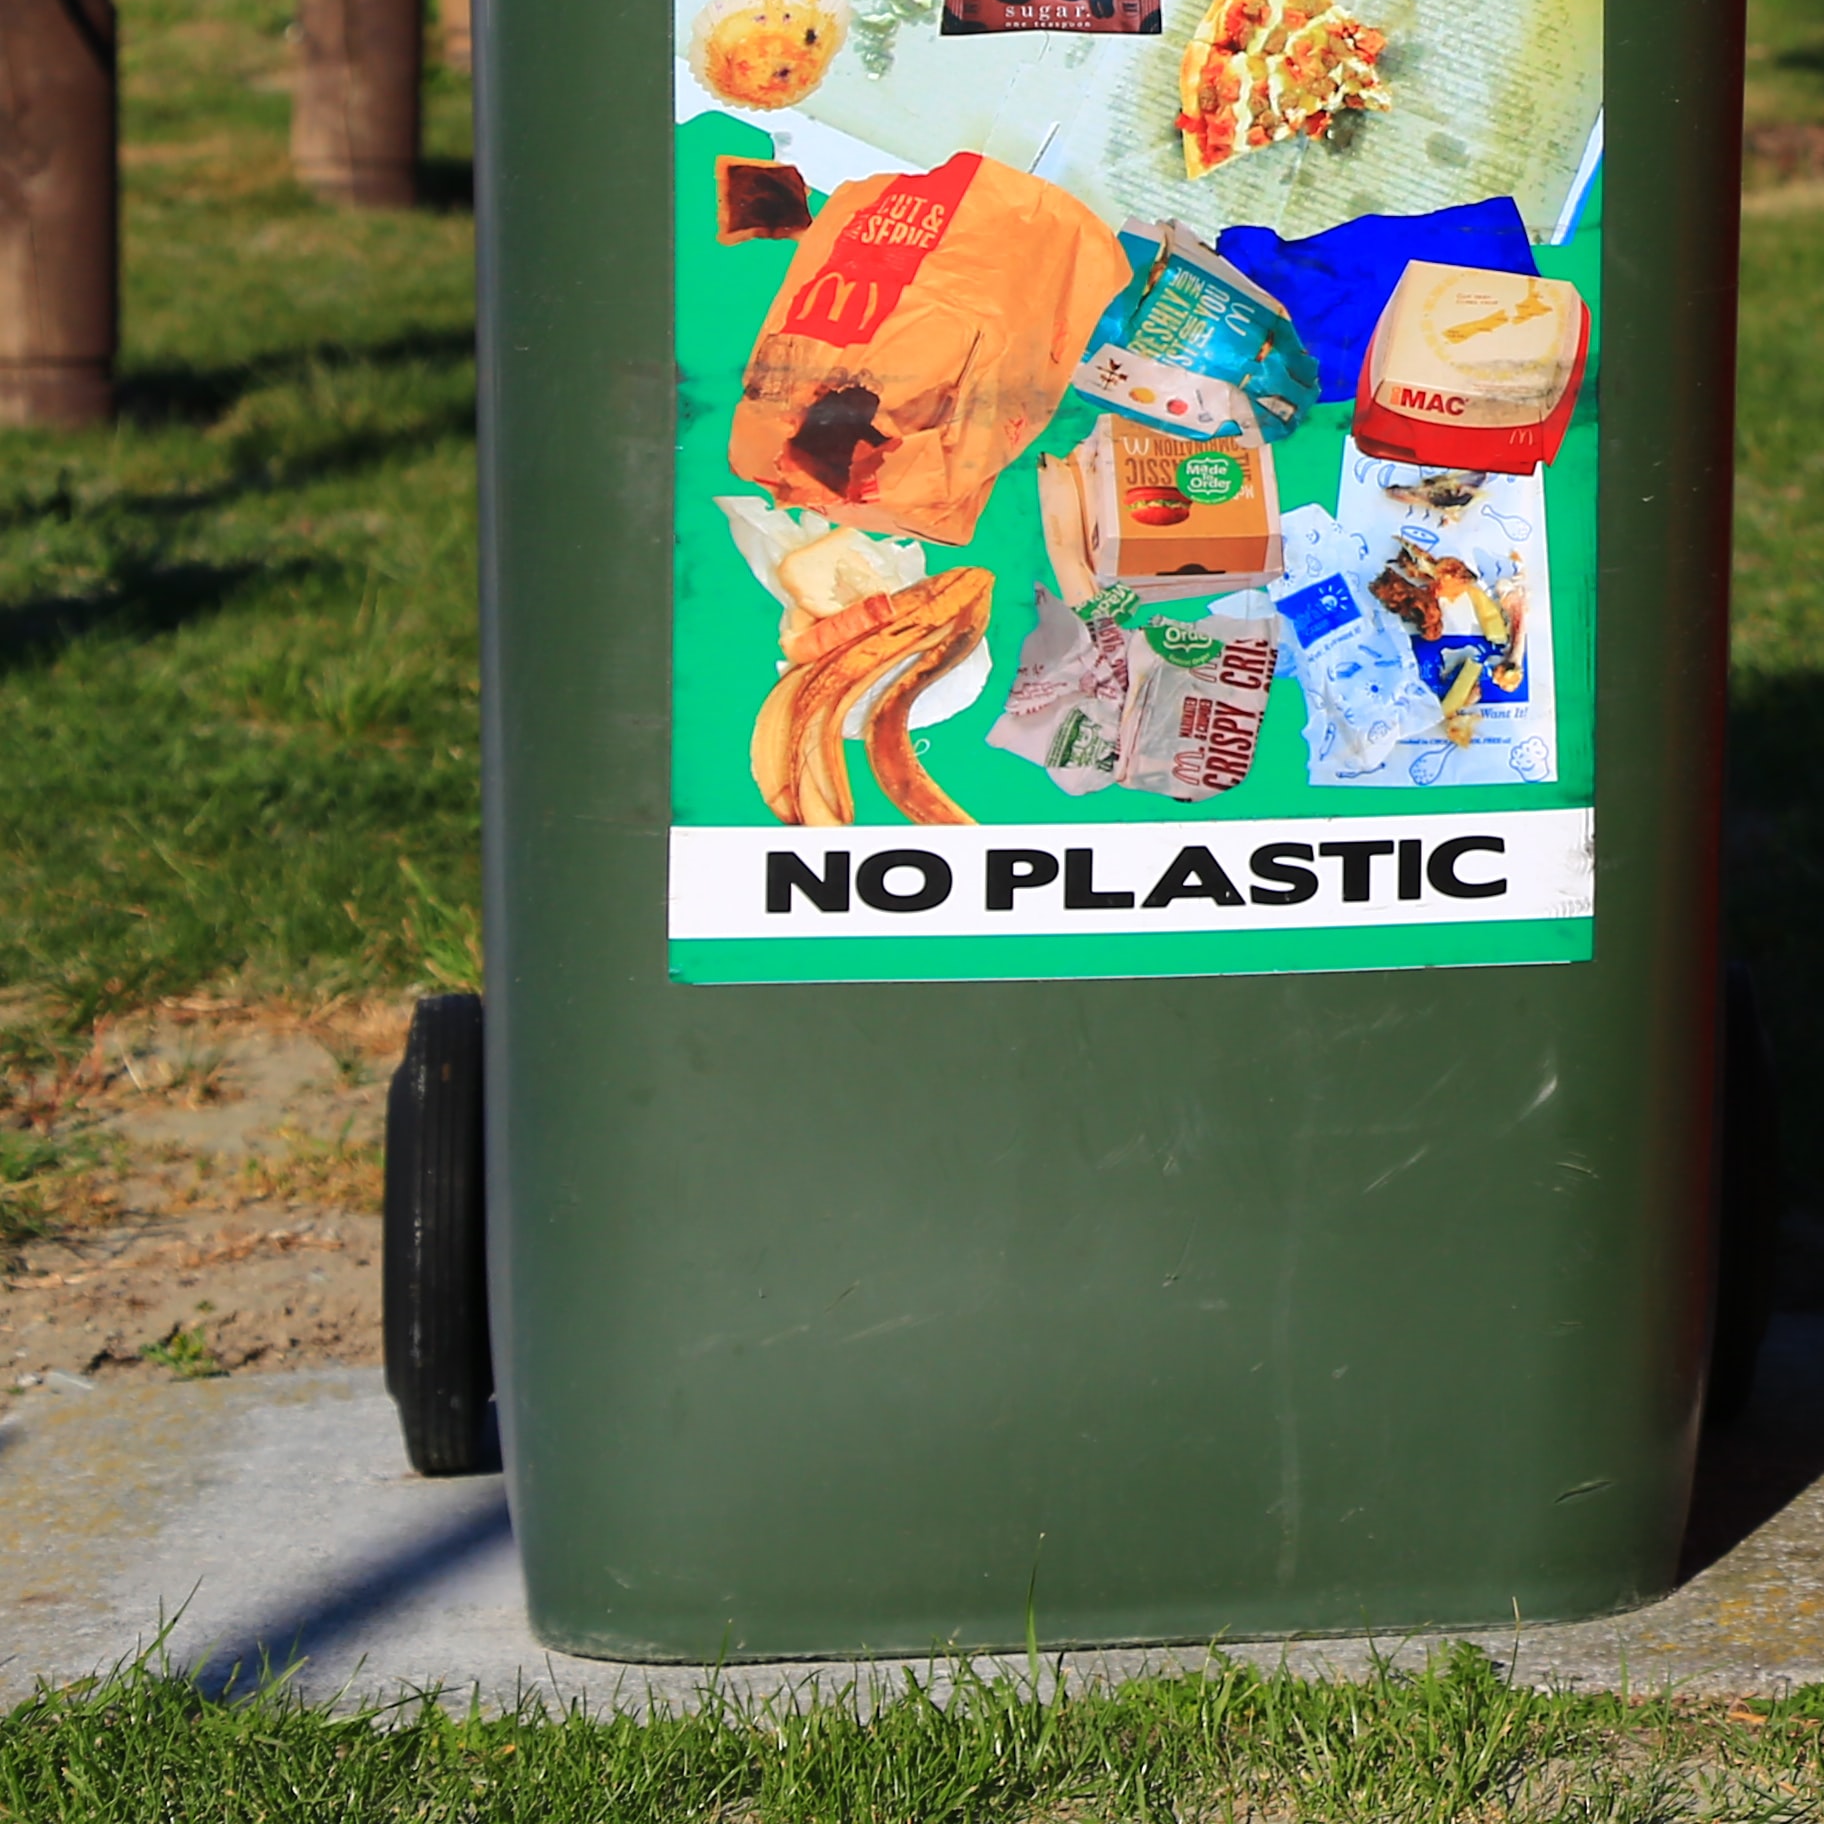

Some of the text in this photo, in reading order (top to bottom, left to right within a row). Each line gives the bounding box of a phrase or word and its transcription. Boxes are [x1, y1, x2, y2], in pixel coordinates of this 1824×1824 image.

[1005, 5, 1092, 21] sugar.
[1034, 20, 1092, 30] teaspoon
[921, 203, 945, 235] &
[1194, 283, 1231, 322] YOU
[1186, 463, 1228, 476] Made
[1190, 476, 1232, 489] Order
[1480, 708, 1511, 720] Want
[1201, 701, 1258, 792] CRISPY
[766, 834, 1509, 914] NO PLASTIC
